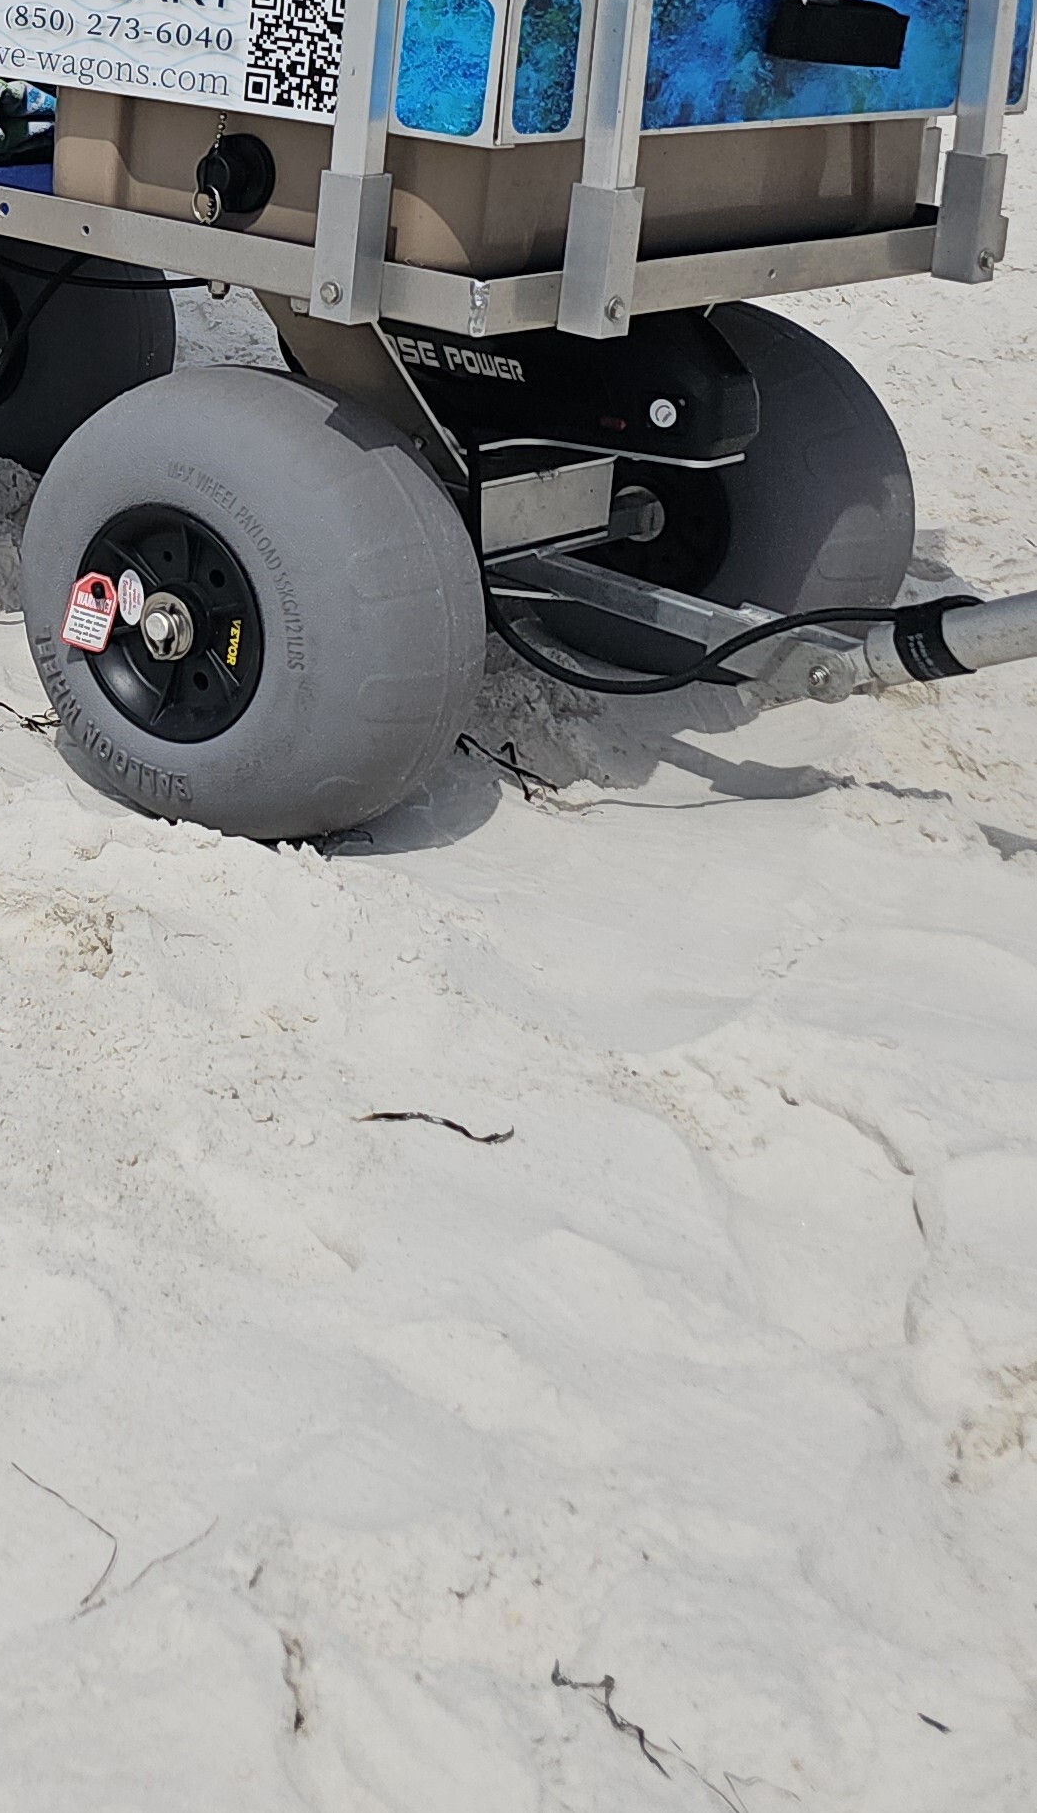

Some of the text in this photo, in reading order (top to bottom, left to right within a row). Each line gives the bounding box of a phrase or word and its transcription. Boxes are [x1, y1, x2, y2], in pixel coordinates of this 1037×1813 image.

[4, 6, 75, 36] (850)
[87, 14, 233, 52] 273-6040
[443, 344, 525, 382] POWER
[196, 471, 237, 514] WHEEL
[234, 506, 282, 570] PAYLOAD
[35, 625, 82, 725] WHEEL
[227, 619, 242, 667] VEVOR
[83, 719, 192, 800] BALLOON
